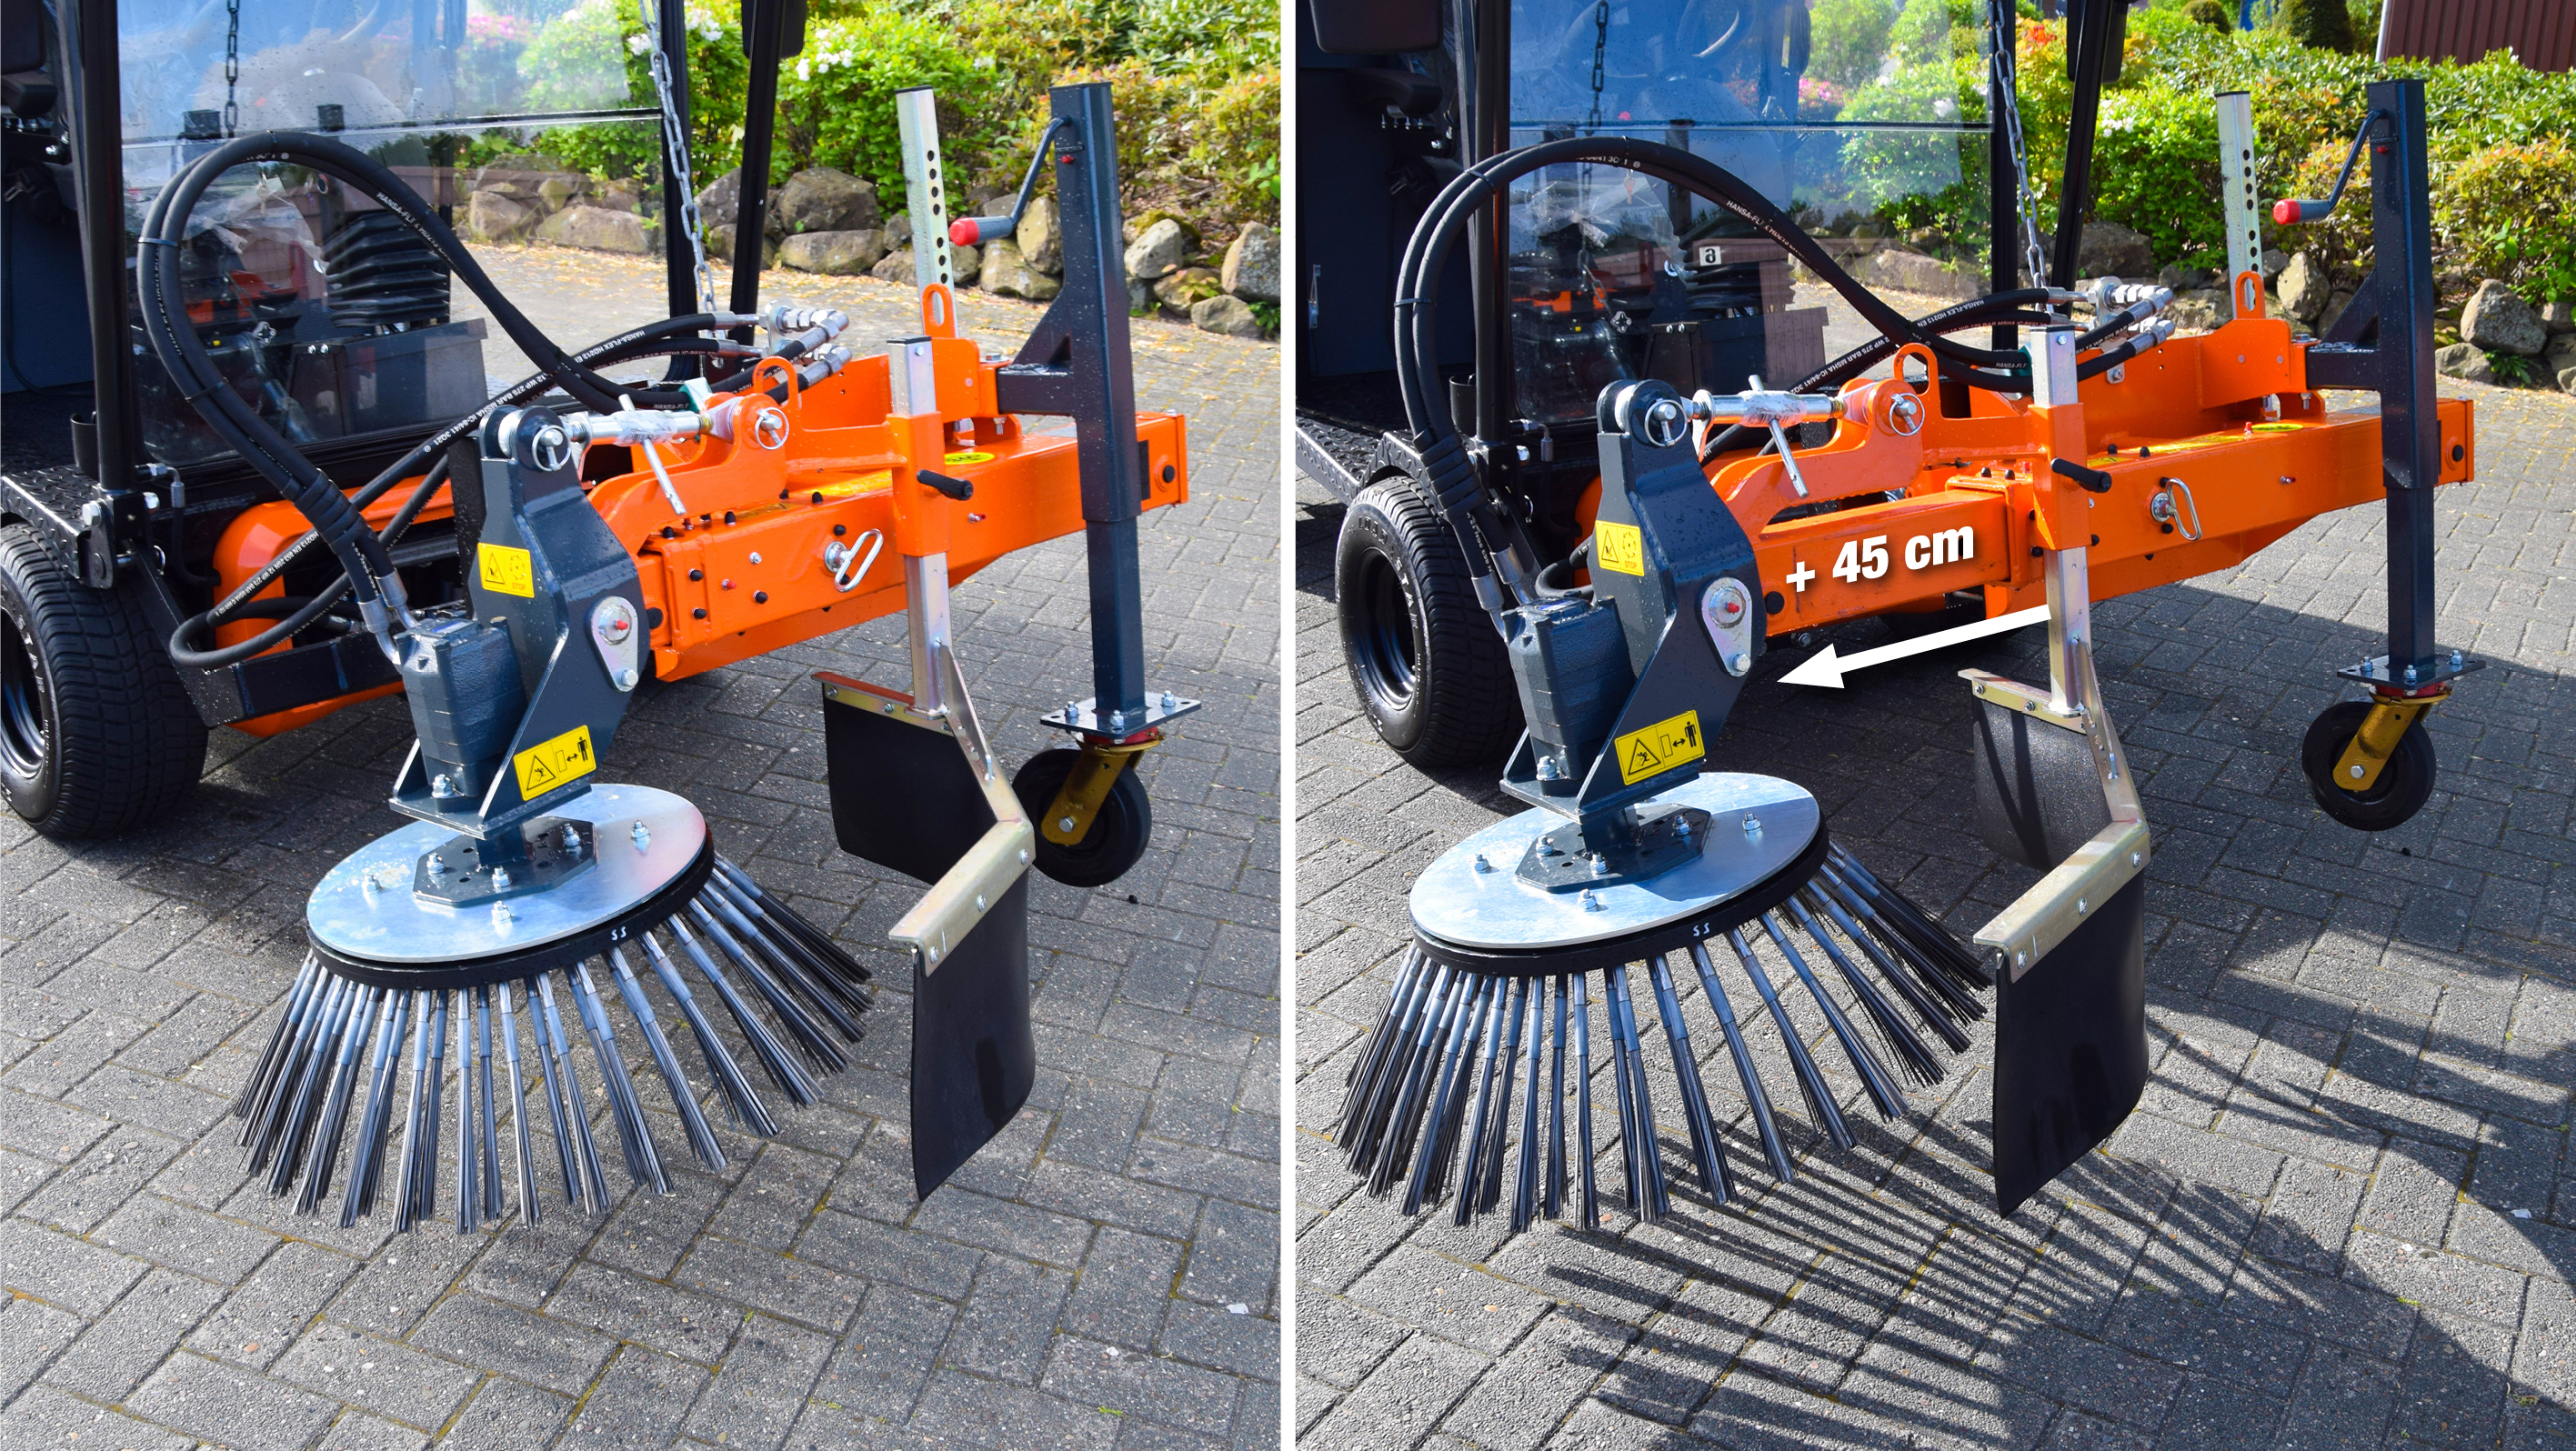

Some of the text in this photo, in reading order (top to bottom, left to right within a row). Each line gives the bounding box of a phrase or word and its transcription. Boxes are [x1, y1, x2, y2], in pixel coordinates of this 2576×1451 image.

[1916, 299, 1984, 327] HANSA-FLEX HD213 EN
[603, 329, 645, 350] HANSA-FLEX
[1872, 338, 1884, 348] WP
[582, 345, 604, 359] HD213
[1861, 344, 1873, 354] 275
[1847, 350, 1861, 361] BAR
[1828, 358, 1847, 372] MSHA
[524, 378, 537, 389] WP
[1803, 369, 1828, 386] IC-84/41
[512, 385, 526, 395] 275
[1789, 384, 1803, 395] 3Q2
[496, 392, 513, 405] BAR
[476, 401, 497, 417] MSHA
[450, 414, 476, 434] IC-84/41
[433, 430, 451, 445] 3Q21
[300, 531, 319, 549] HD213
[293, 545, 302, 555] EN
[274, 558, 286, 570] 2SN
[1624, 561, 1638, 569] STOP
[260, 571, 270, 581] WP
[512, 582, 526, 591] STOP
